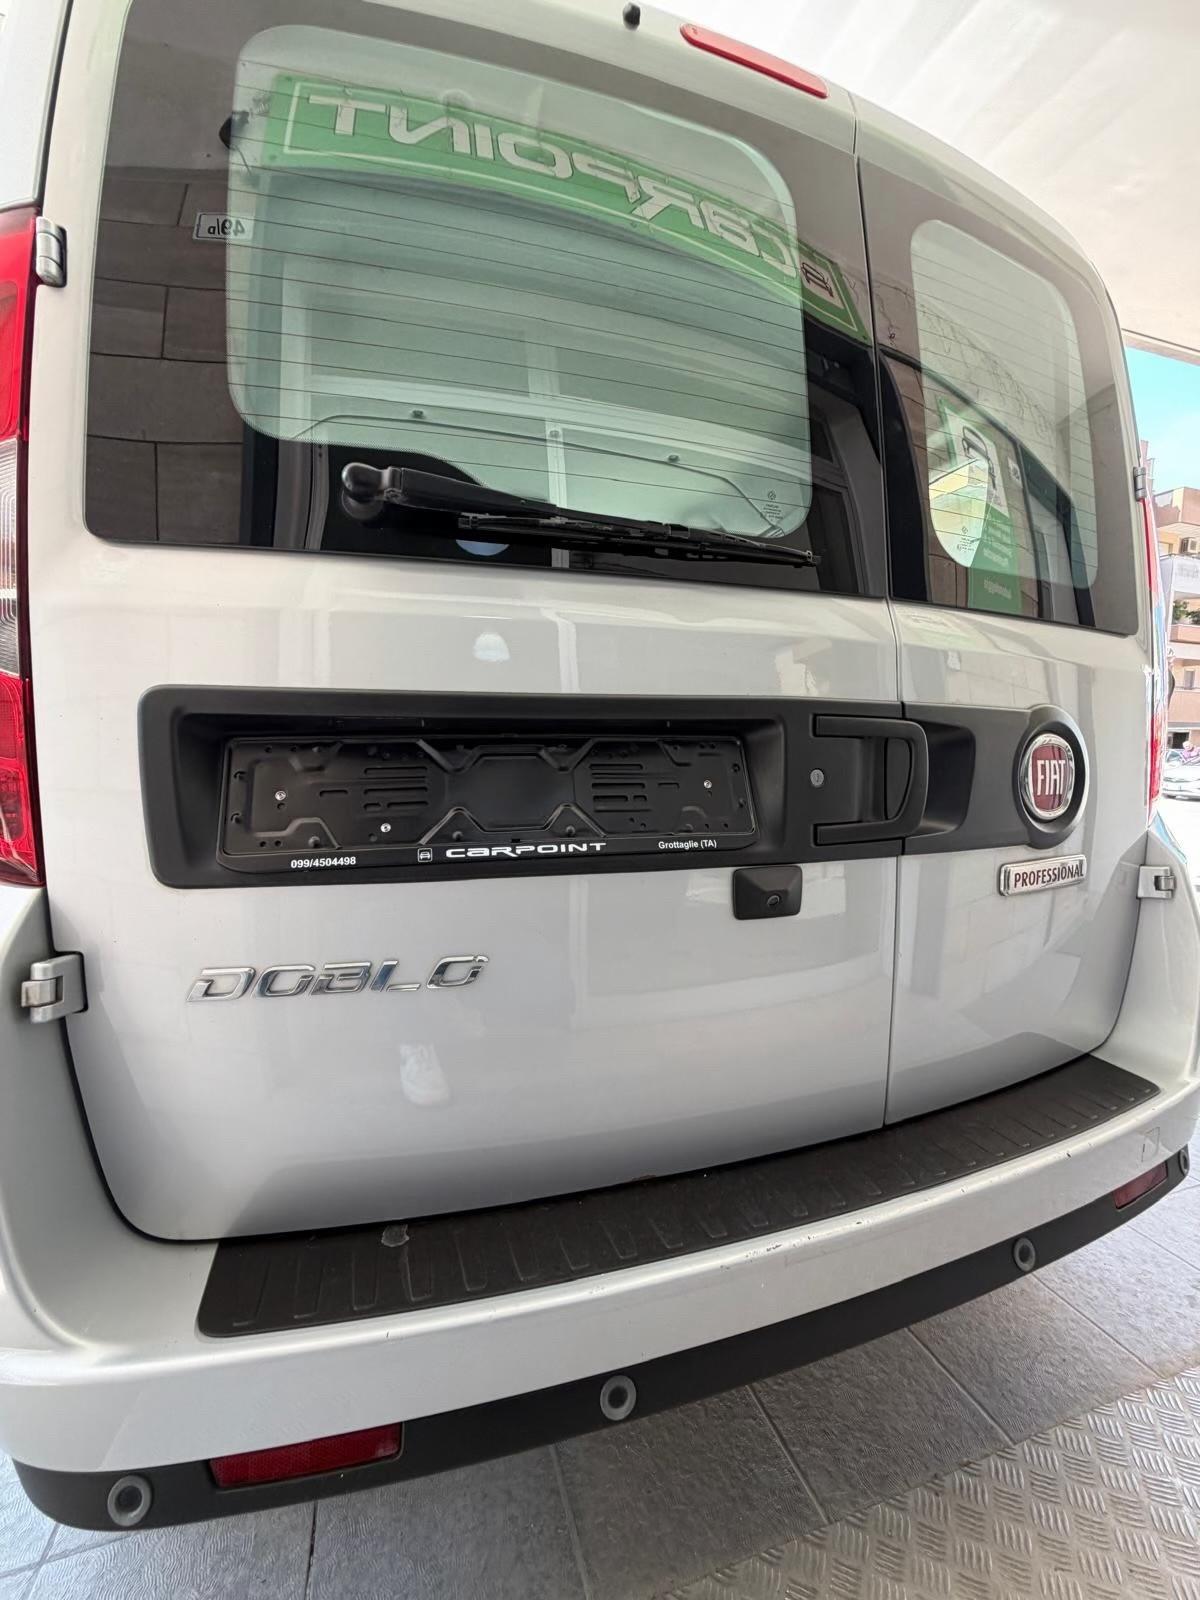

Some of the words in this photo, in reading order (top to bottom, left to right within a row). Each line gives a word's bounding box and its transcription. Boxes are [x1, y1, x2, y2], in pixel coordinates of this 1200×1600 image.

[1036, 759, 1066, 796] FIAT
[658, 841, 699, 851] Grottaglie
[700, 839, 717, 849] (TA)
[290, 856, 357, 869] 099/4504498
[1014, 865, 1084, 889] PROFESSIONAL
